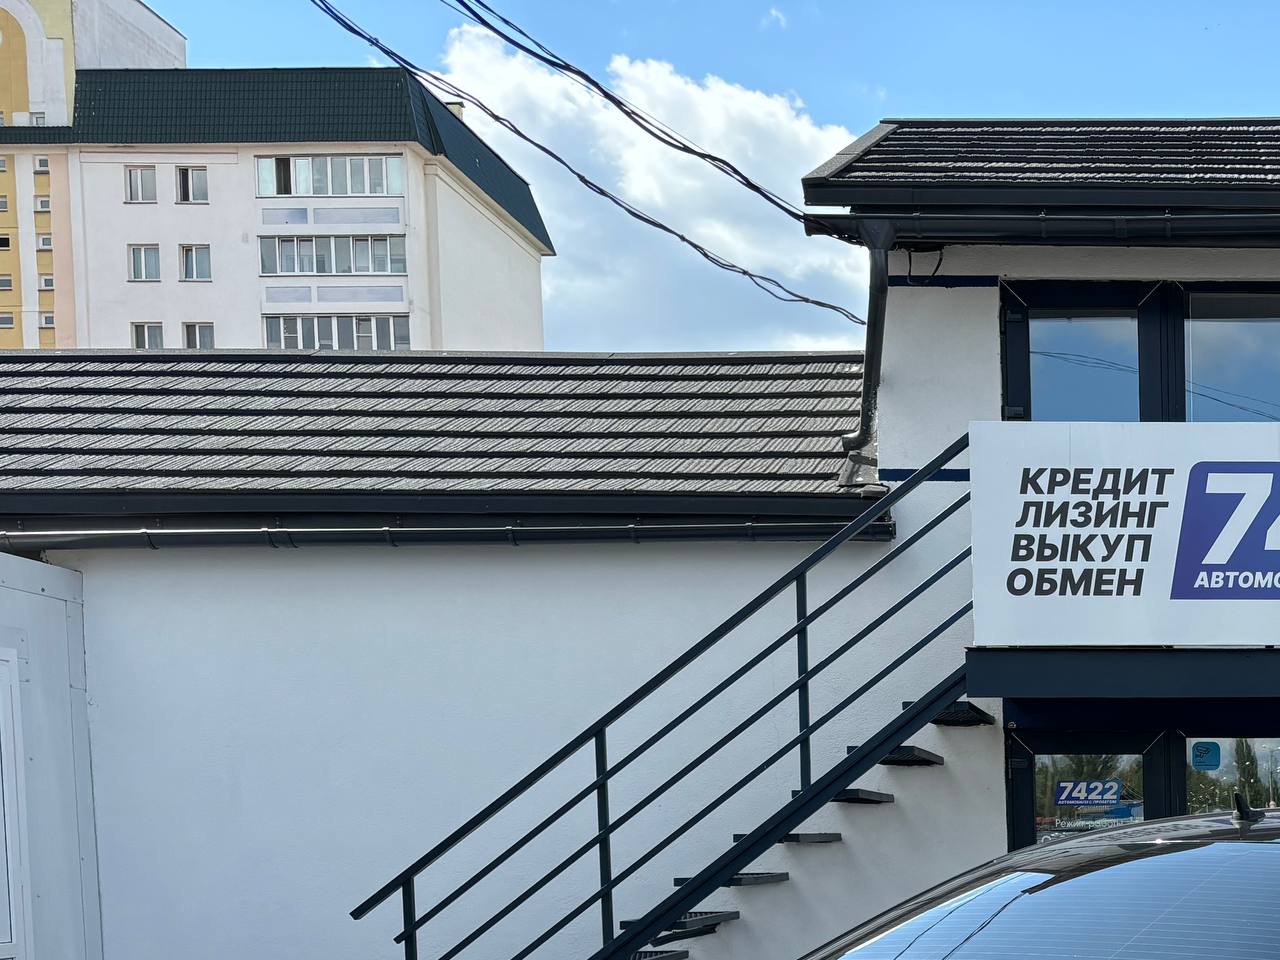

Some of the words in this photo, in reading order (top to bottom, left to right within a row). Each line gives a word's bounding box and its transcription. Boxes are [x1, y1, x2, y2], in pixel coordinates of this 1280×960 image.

[1019, 467, 1175, 501] КРЕДИТ
[1015, 501, 1169, 528] ЛИЗИНГ
[1010, 534, 1152, 562] ВЫКУП
[1006, 567, 1145, 596] ОБМЕН
[1059, 781, 1119, 800] 7422
[1055, 819, 1087, 828] Режим
